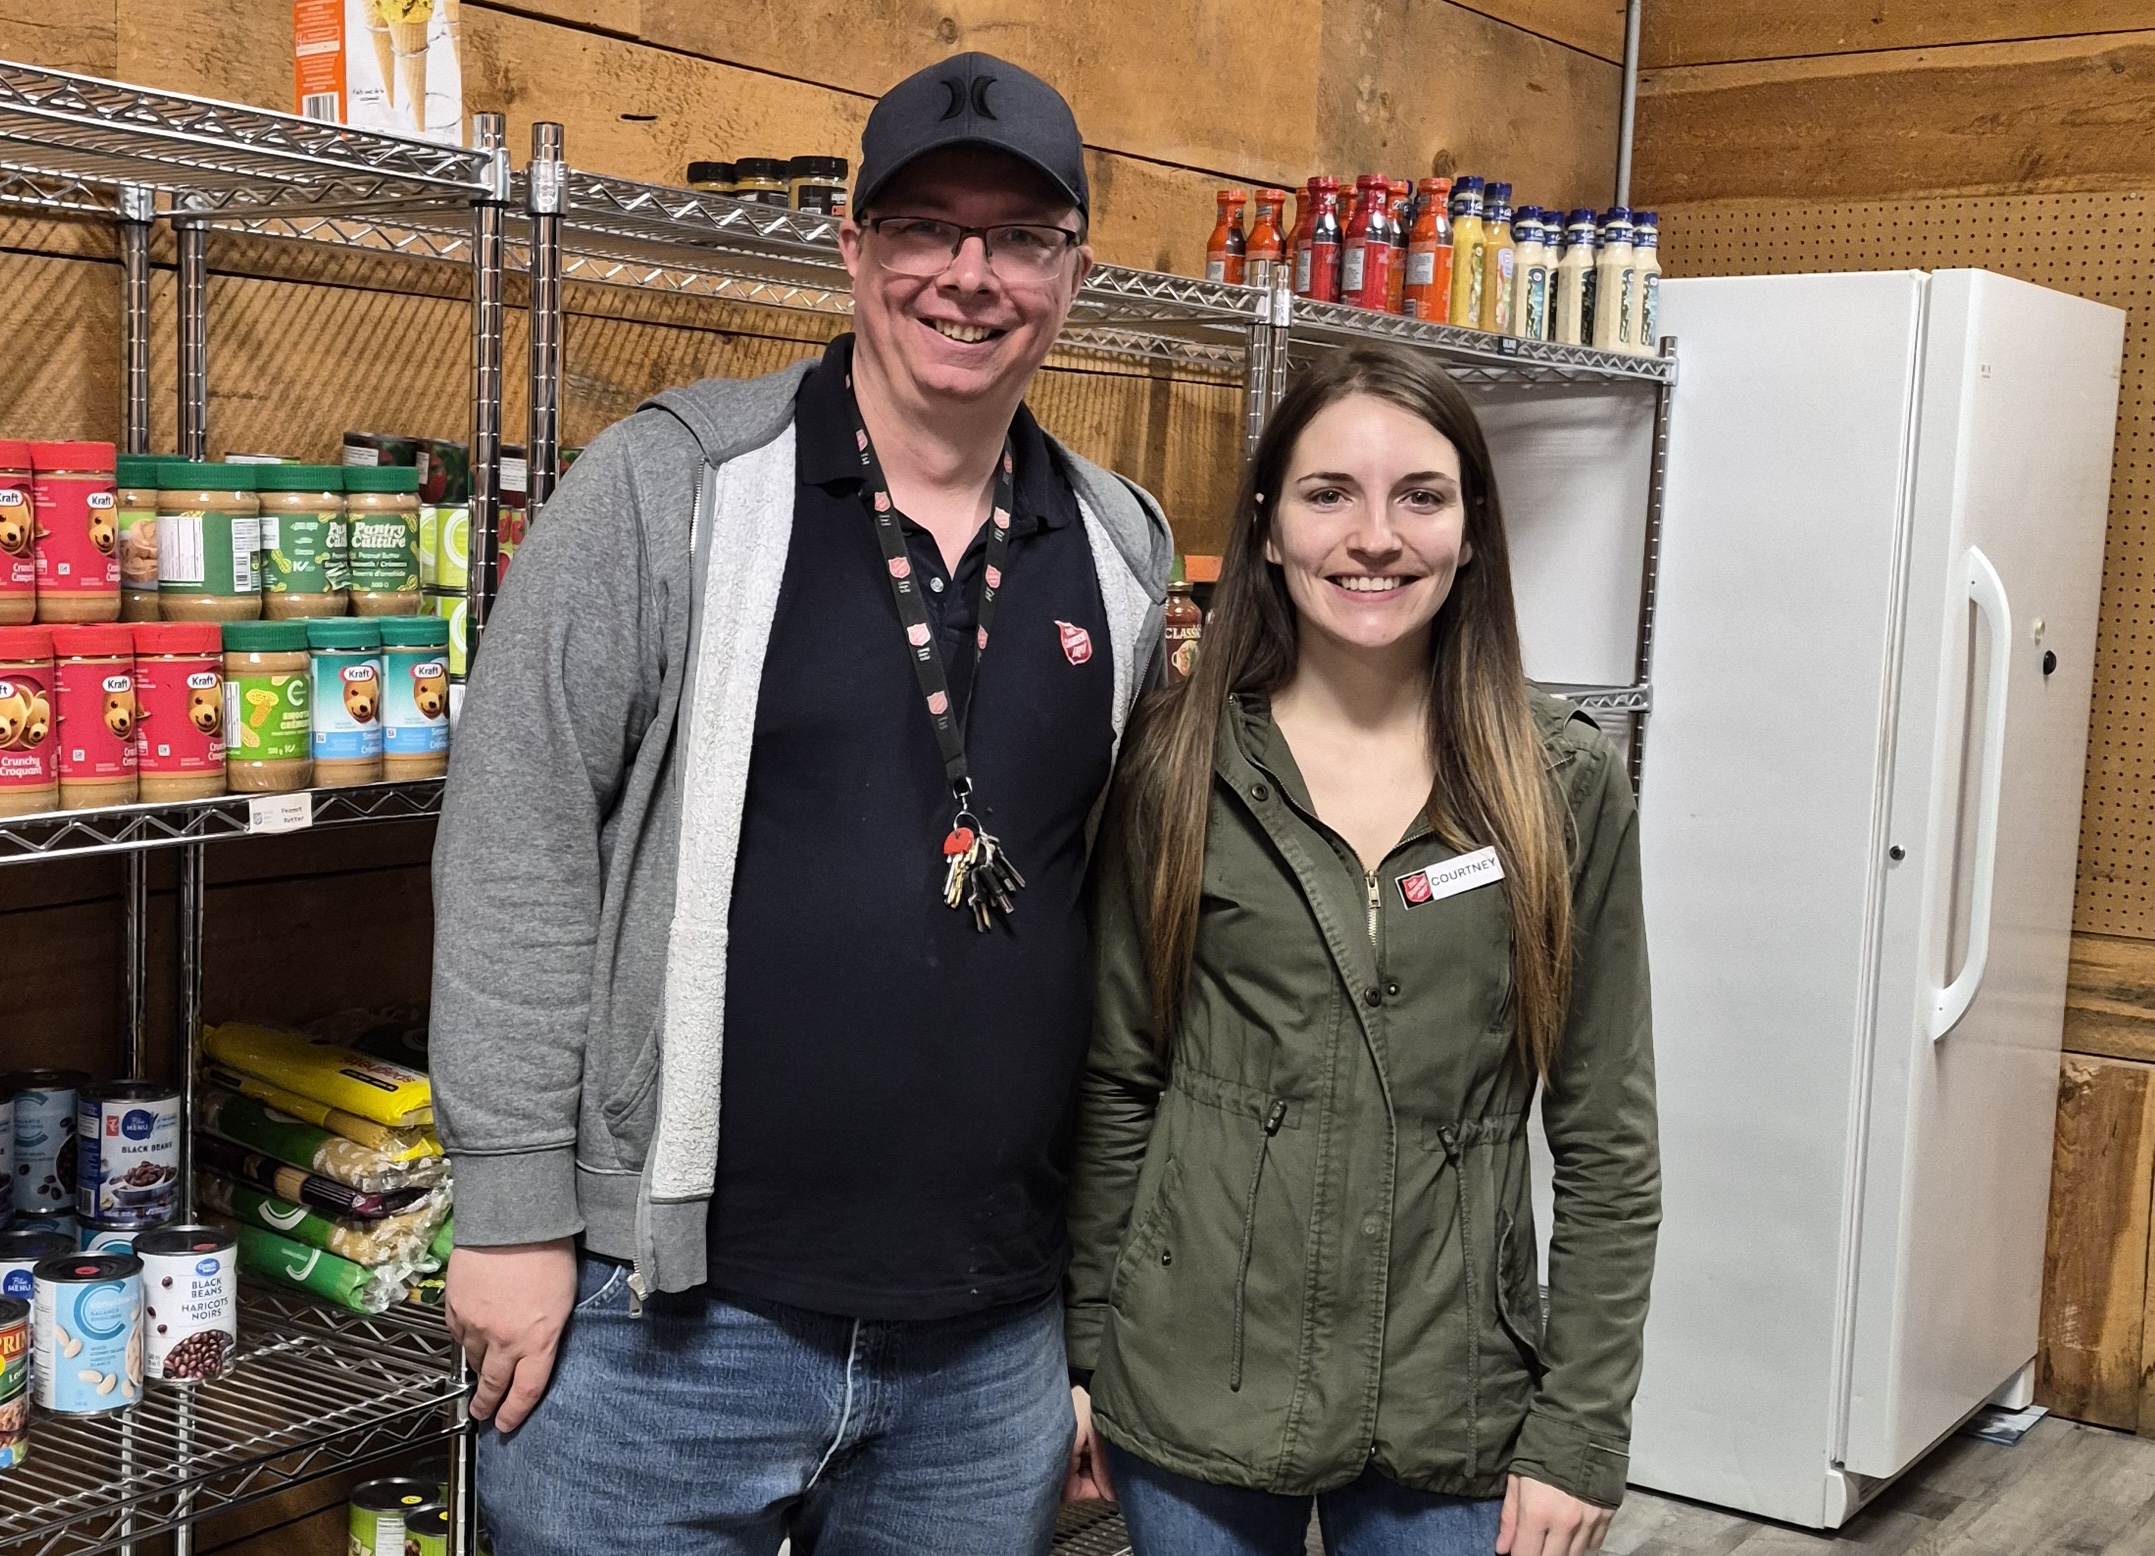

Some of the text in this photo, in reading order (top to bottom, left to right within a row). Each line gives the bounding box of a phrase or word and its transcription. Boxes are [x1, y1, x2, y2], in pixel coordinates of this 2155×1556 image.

[92, 496, 111, 505] Kraft
[354, 521, 406, 538] Pantry
[351, 535, 406, 548] Culture
[348, 669, 370, 679] Kraft
[418, 666, 438, 675] Kraft
[107, 679, 128, 689] Kraft
[192, 676, 214, 686] Kraft
[1, 755, 40, 767] Crunchy
[0, 765, 42, 778] Croquant
[1430, 857, 1496, 886] COURTNEY
[126, 1123, 149, 1131] MENU
[121, 1141, 173, 1154] BLACK BEANS
[7, 1284, 31, 1292] MENU
[191, 1277, 222, 1289] BLACK
[191, 1286, 222, 1298] BEANS
[181, 1297, 229, 1312] HARICOTS
[191, 1309, 222, 1321] NOIRS
